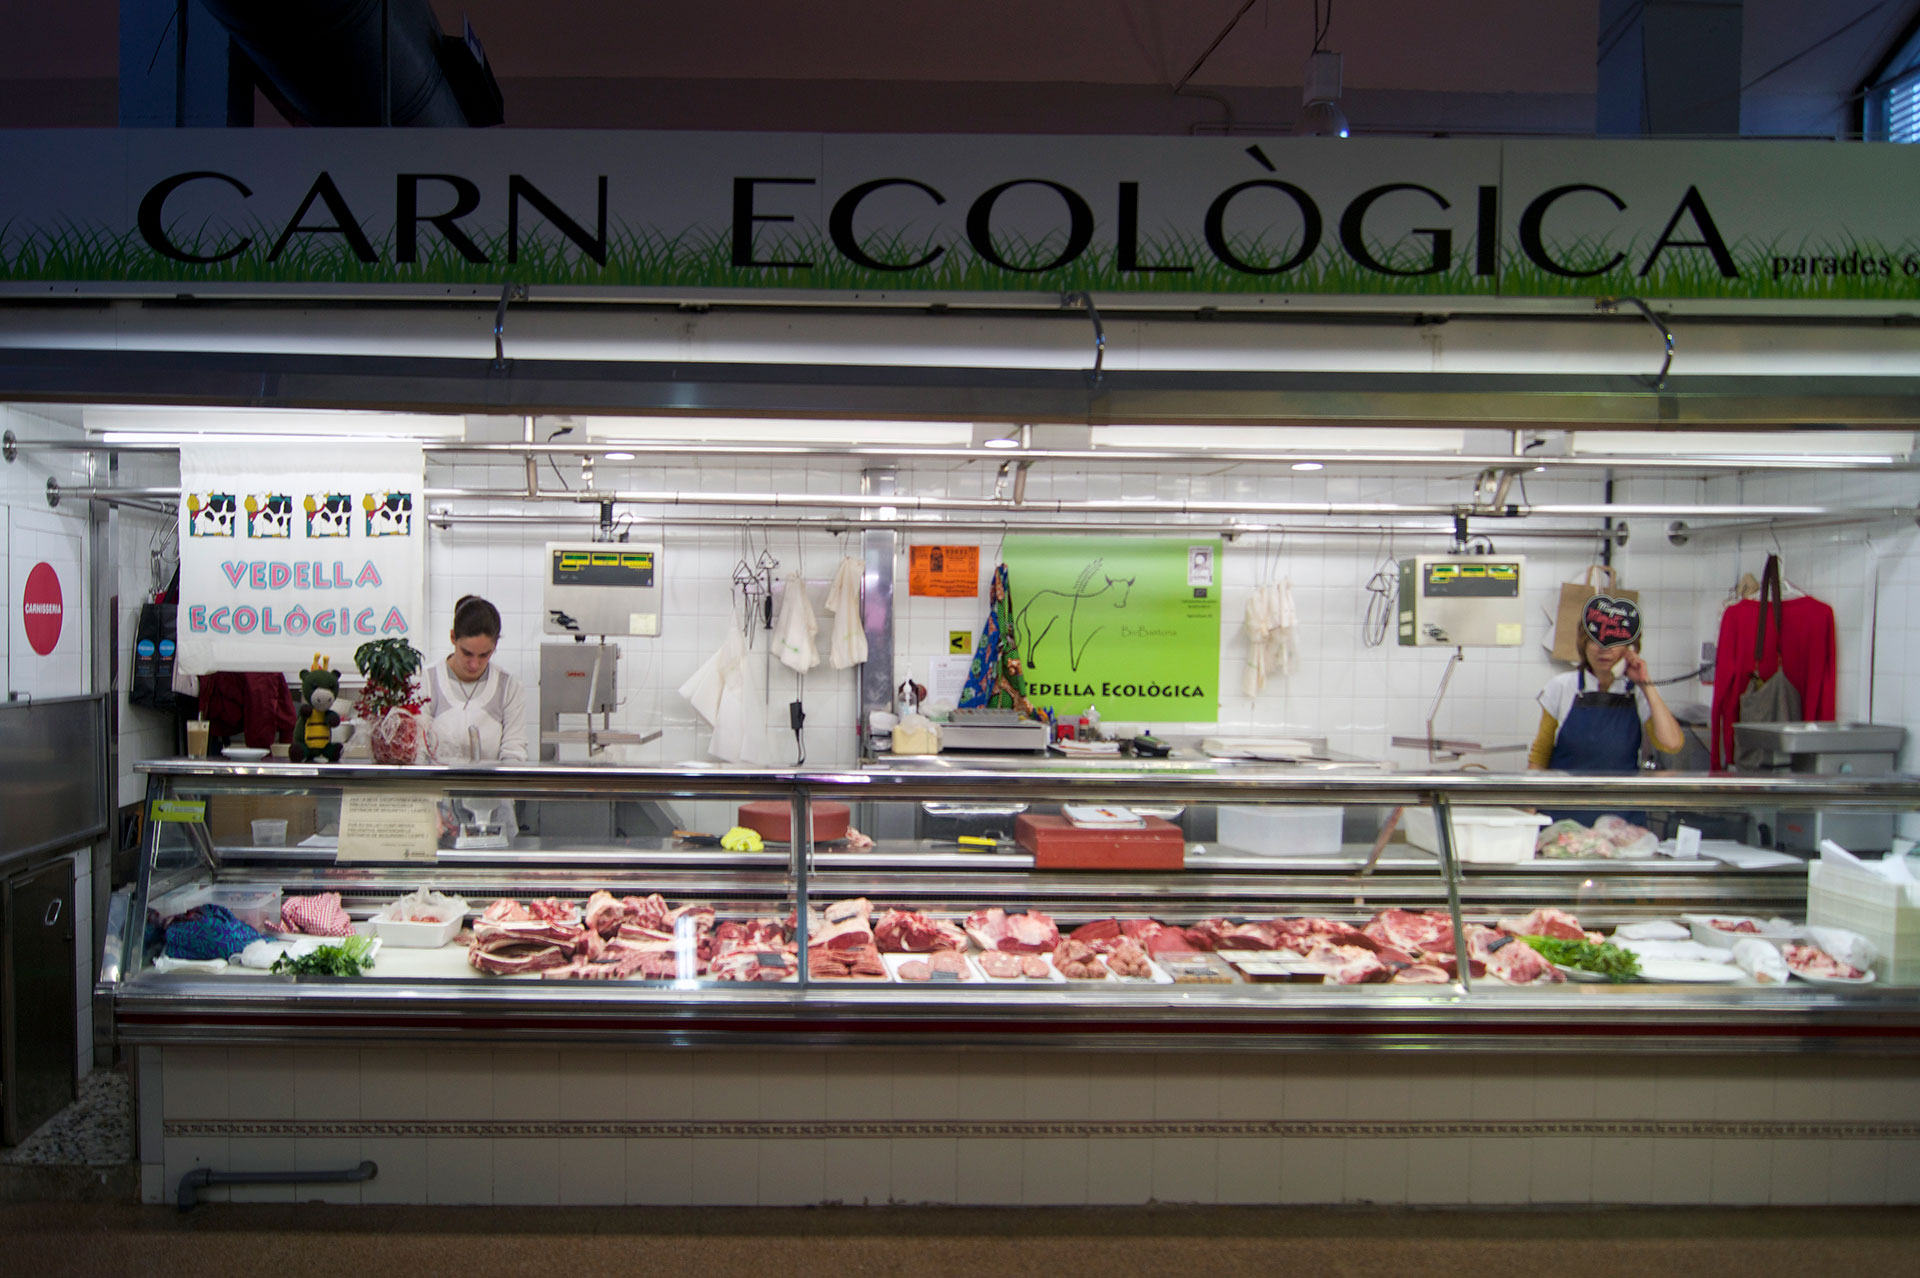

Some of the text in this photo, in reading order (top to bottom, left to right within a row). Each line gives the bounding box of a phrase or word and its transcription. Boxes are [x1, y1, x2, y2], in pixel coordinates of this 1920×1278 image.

[138, 172, 608, 269] CARN
[731, 145, 1741, 278] ECOLÒGICA
[1772, 250, 1892, 281] parades
[222, 560, 382, 589] VEDELLA
[25, 602, 61, 615] CARNISSERIA
[189, 604, 408, 636] ECOLÒGICA
[1025, 682, 1095, 697] EDELLA
